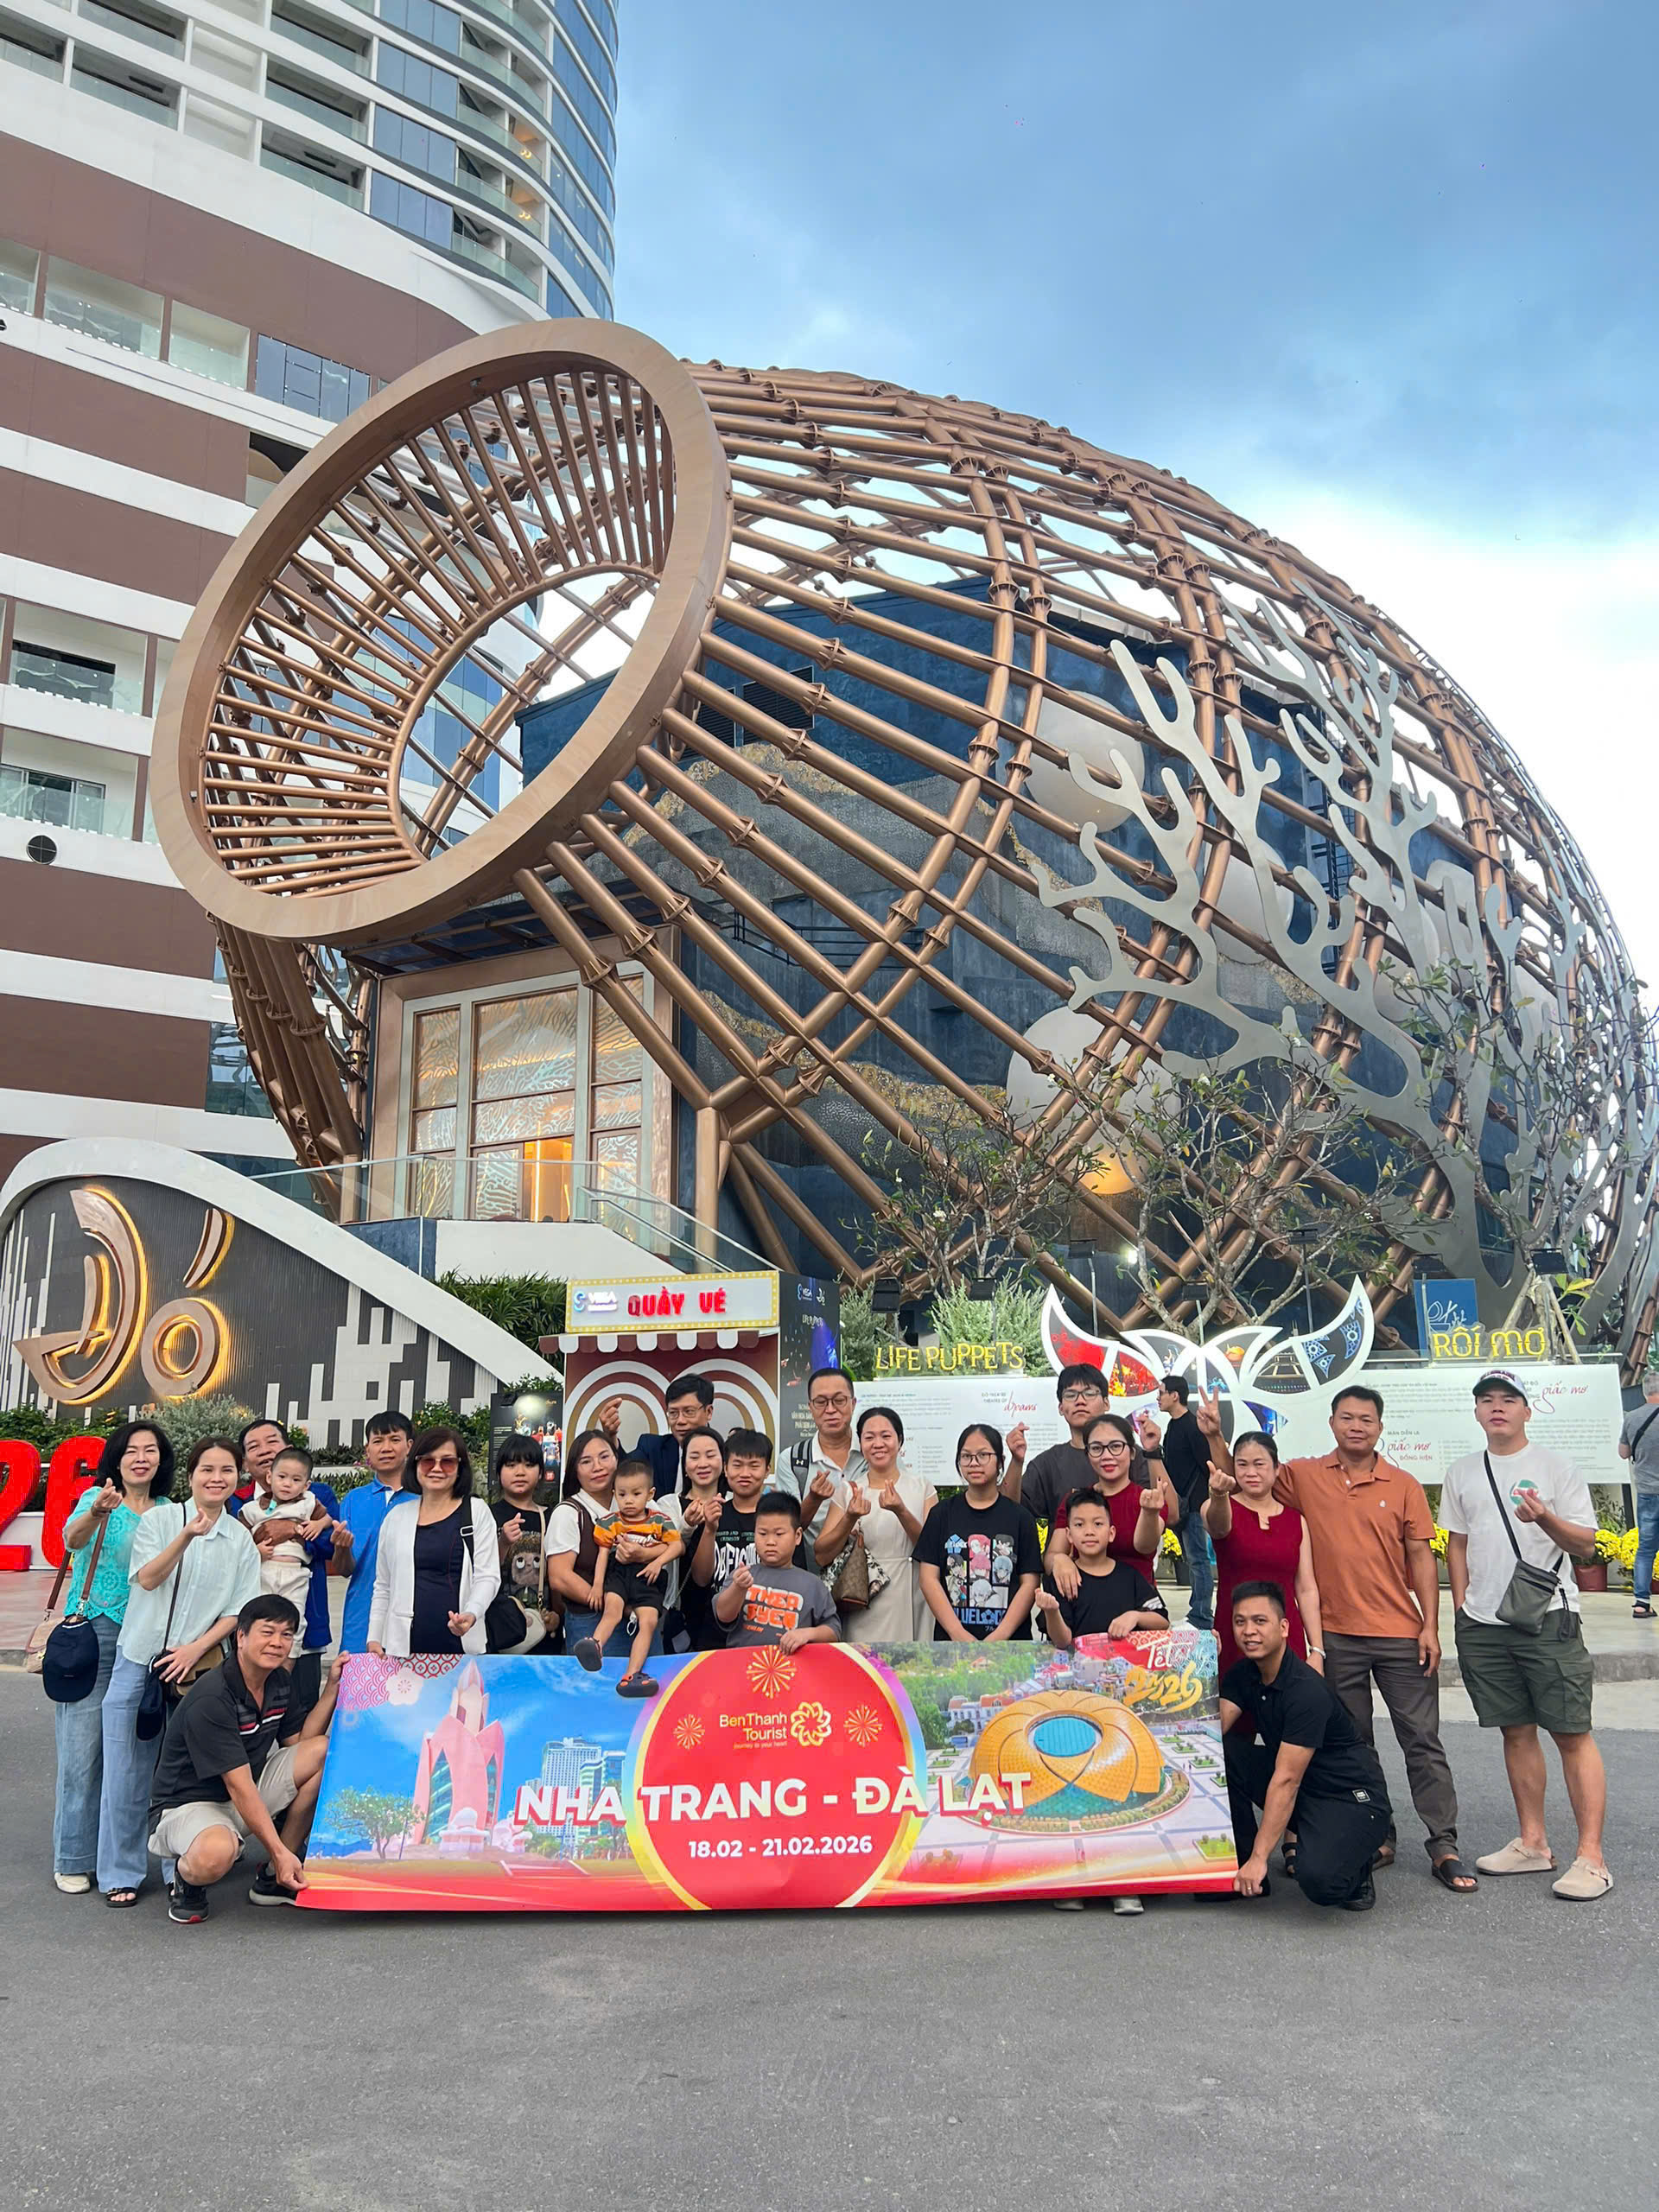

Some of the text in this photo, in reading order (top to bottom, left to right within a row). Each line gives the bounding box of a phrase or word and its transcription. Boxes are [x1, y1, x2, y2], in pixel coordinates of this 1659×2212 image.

[627, 1286, 727, 1317] QUẦY VÉ
[1431, 1325, 1482, 1357] RỐI
[875, 1342, 1024, 1371] LIFE PUPPETS
[1136, 1636, 1192, 1669] Tết
[719, 1712, 788, 1727] BenThanh
[743, 1726, 788, 1741] Tourist
[515, 1785, 628, 1825] NHA
[640, 1778, 807, 1821] TRANG
[852, 1765, 929, 1816] ĐÀ
[939, 1772, 1032, 1826] LẠT
[689, 1840, 743, 1858] 18.02
[762, 1835, 873, 1857] 21.02.2026
